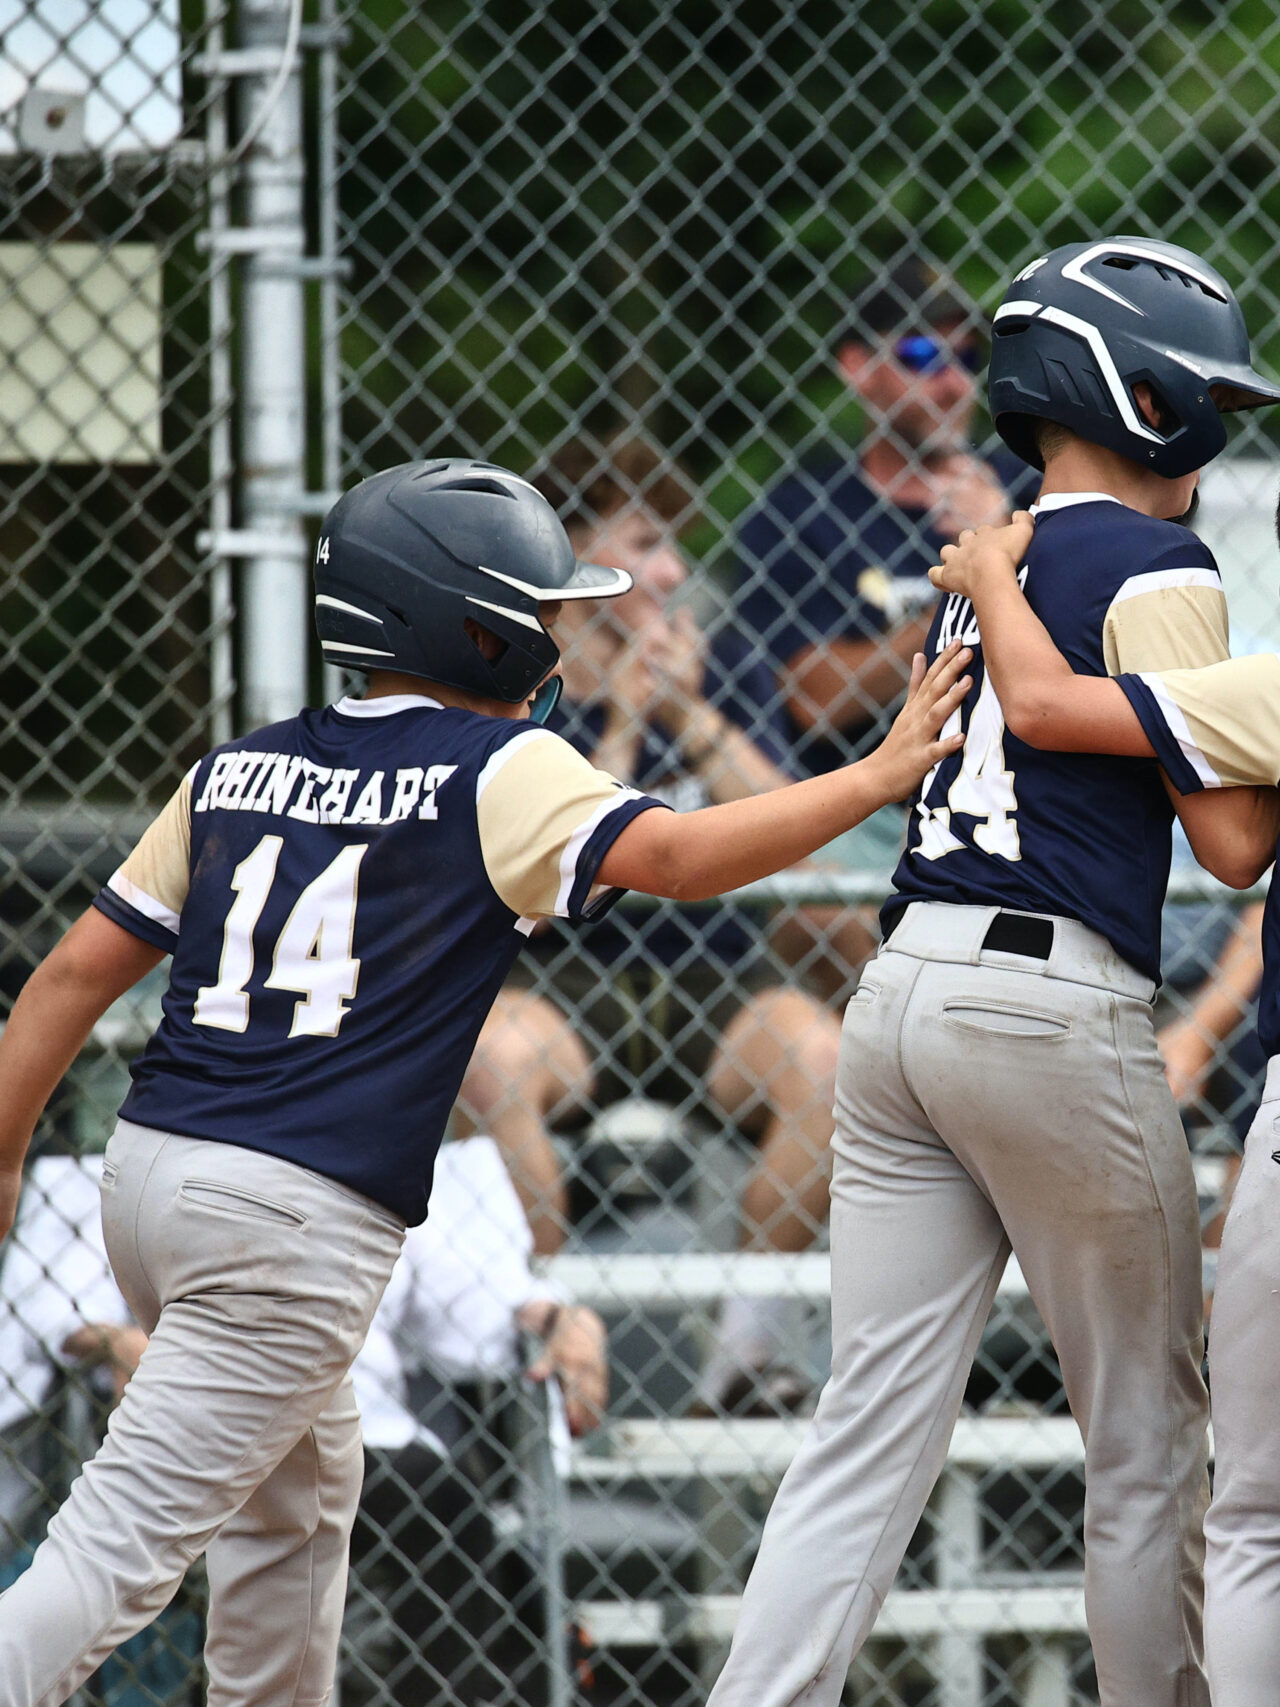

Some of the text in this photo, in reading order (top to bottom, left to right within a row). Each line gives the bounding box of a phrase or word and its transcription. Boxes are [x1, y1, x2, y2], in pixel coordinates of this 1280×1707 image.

[315, 535, 331, 565] 14
[194, 749, 459, 826] RHINEHART
[191, 833, 370, 1038] 14
